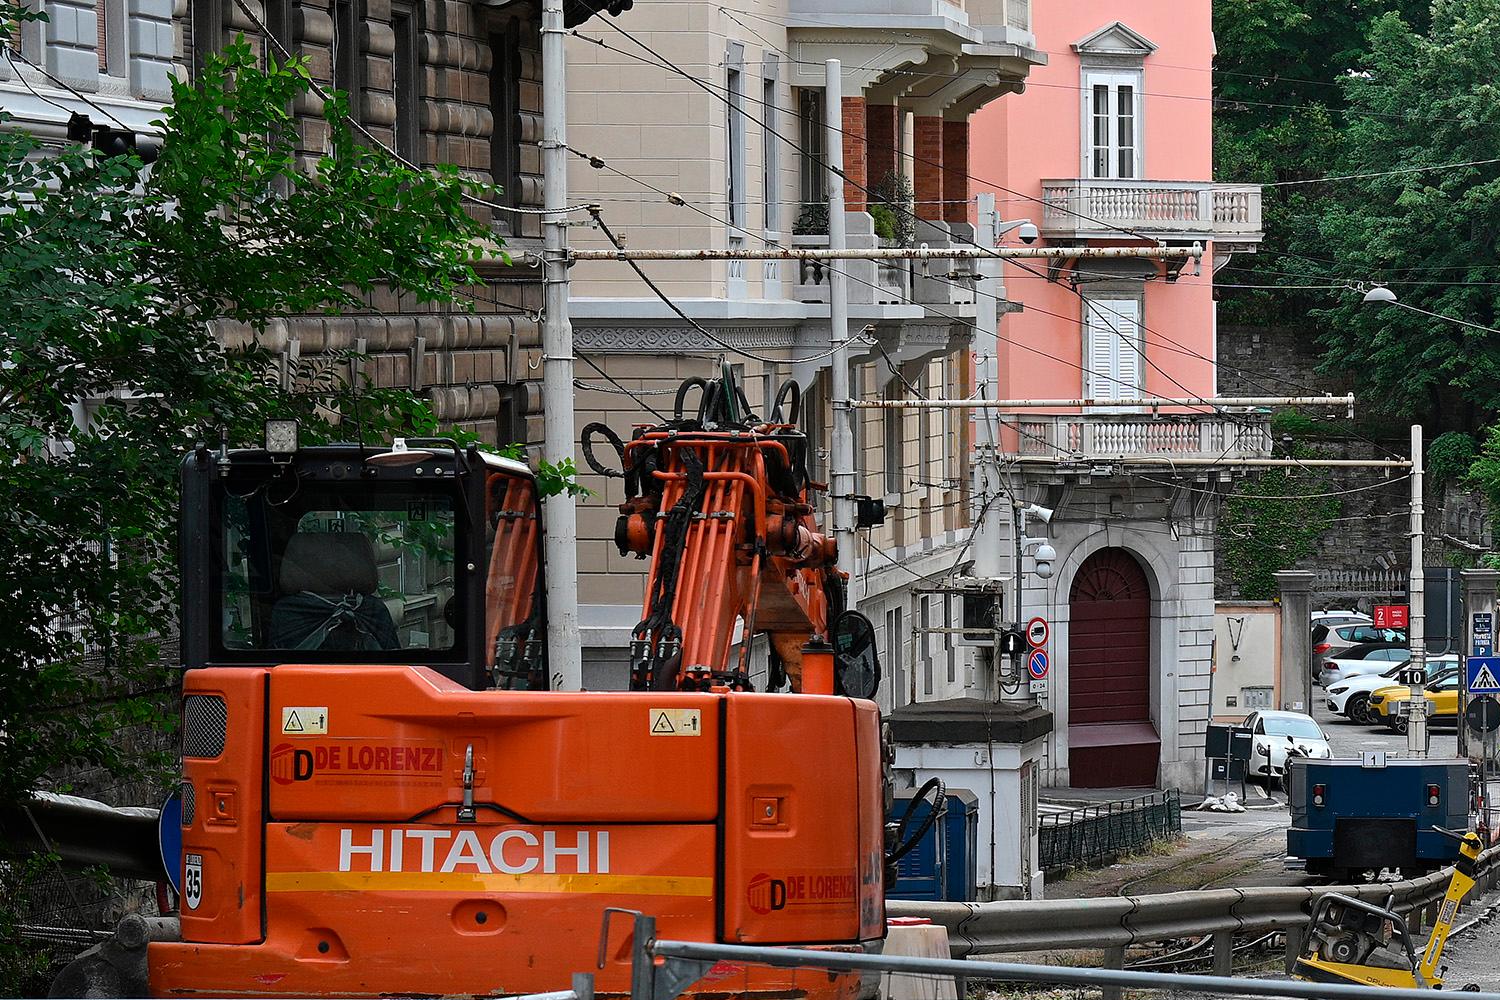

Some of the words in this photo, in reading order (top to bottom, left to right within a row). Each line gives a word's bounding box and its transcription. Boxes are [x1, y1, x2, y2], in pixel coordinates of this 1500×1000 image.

[1378, 611, 1384, 621] 2
[1479, 647, 1486, 656] P
[1404, 671, 1421, 684] 10
[315, 746, 341, 770] DE
[347, 746, 443, 772] LORENZI
[1370, 754, 1376, 765] 1
[338, 828, 611, 875] HITACHI
[186, 868, 201, 899] 35
[787, 875, 805, 900] DE
